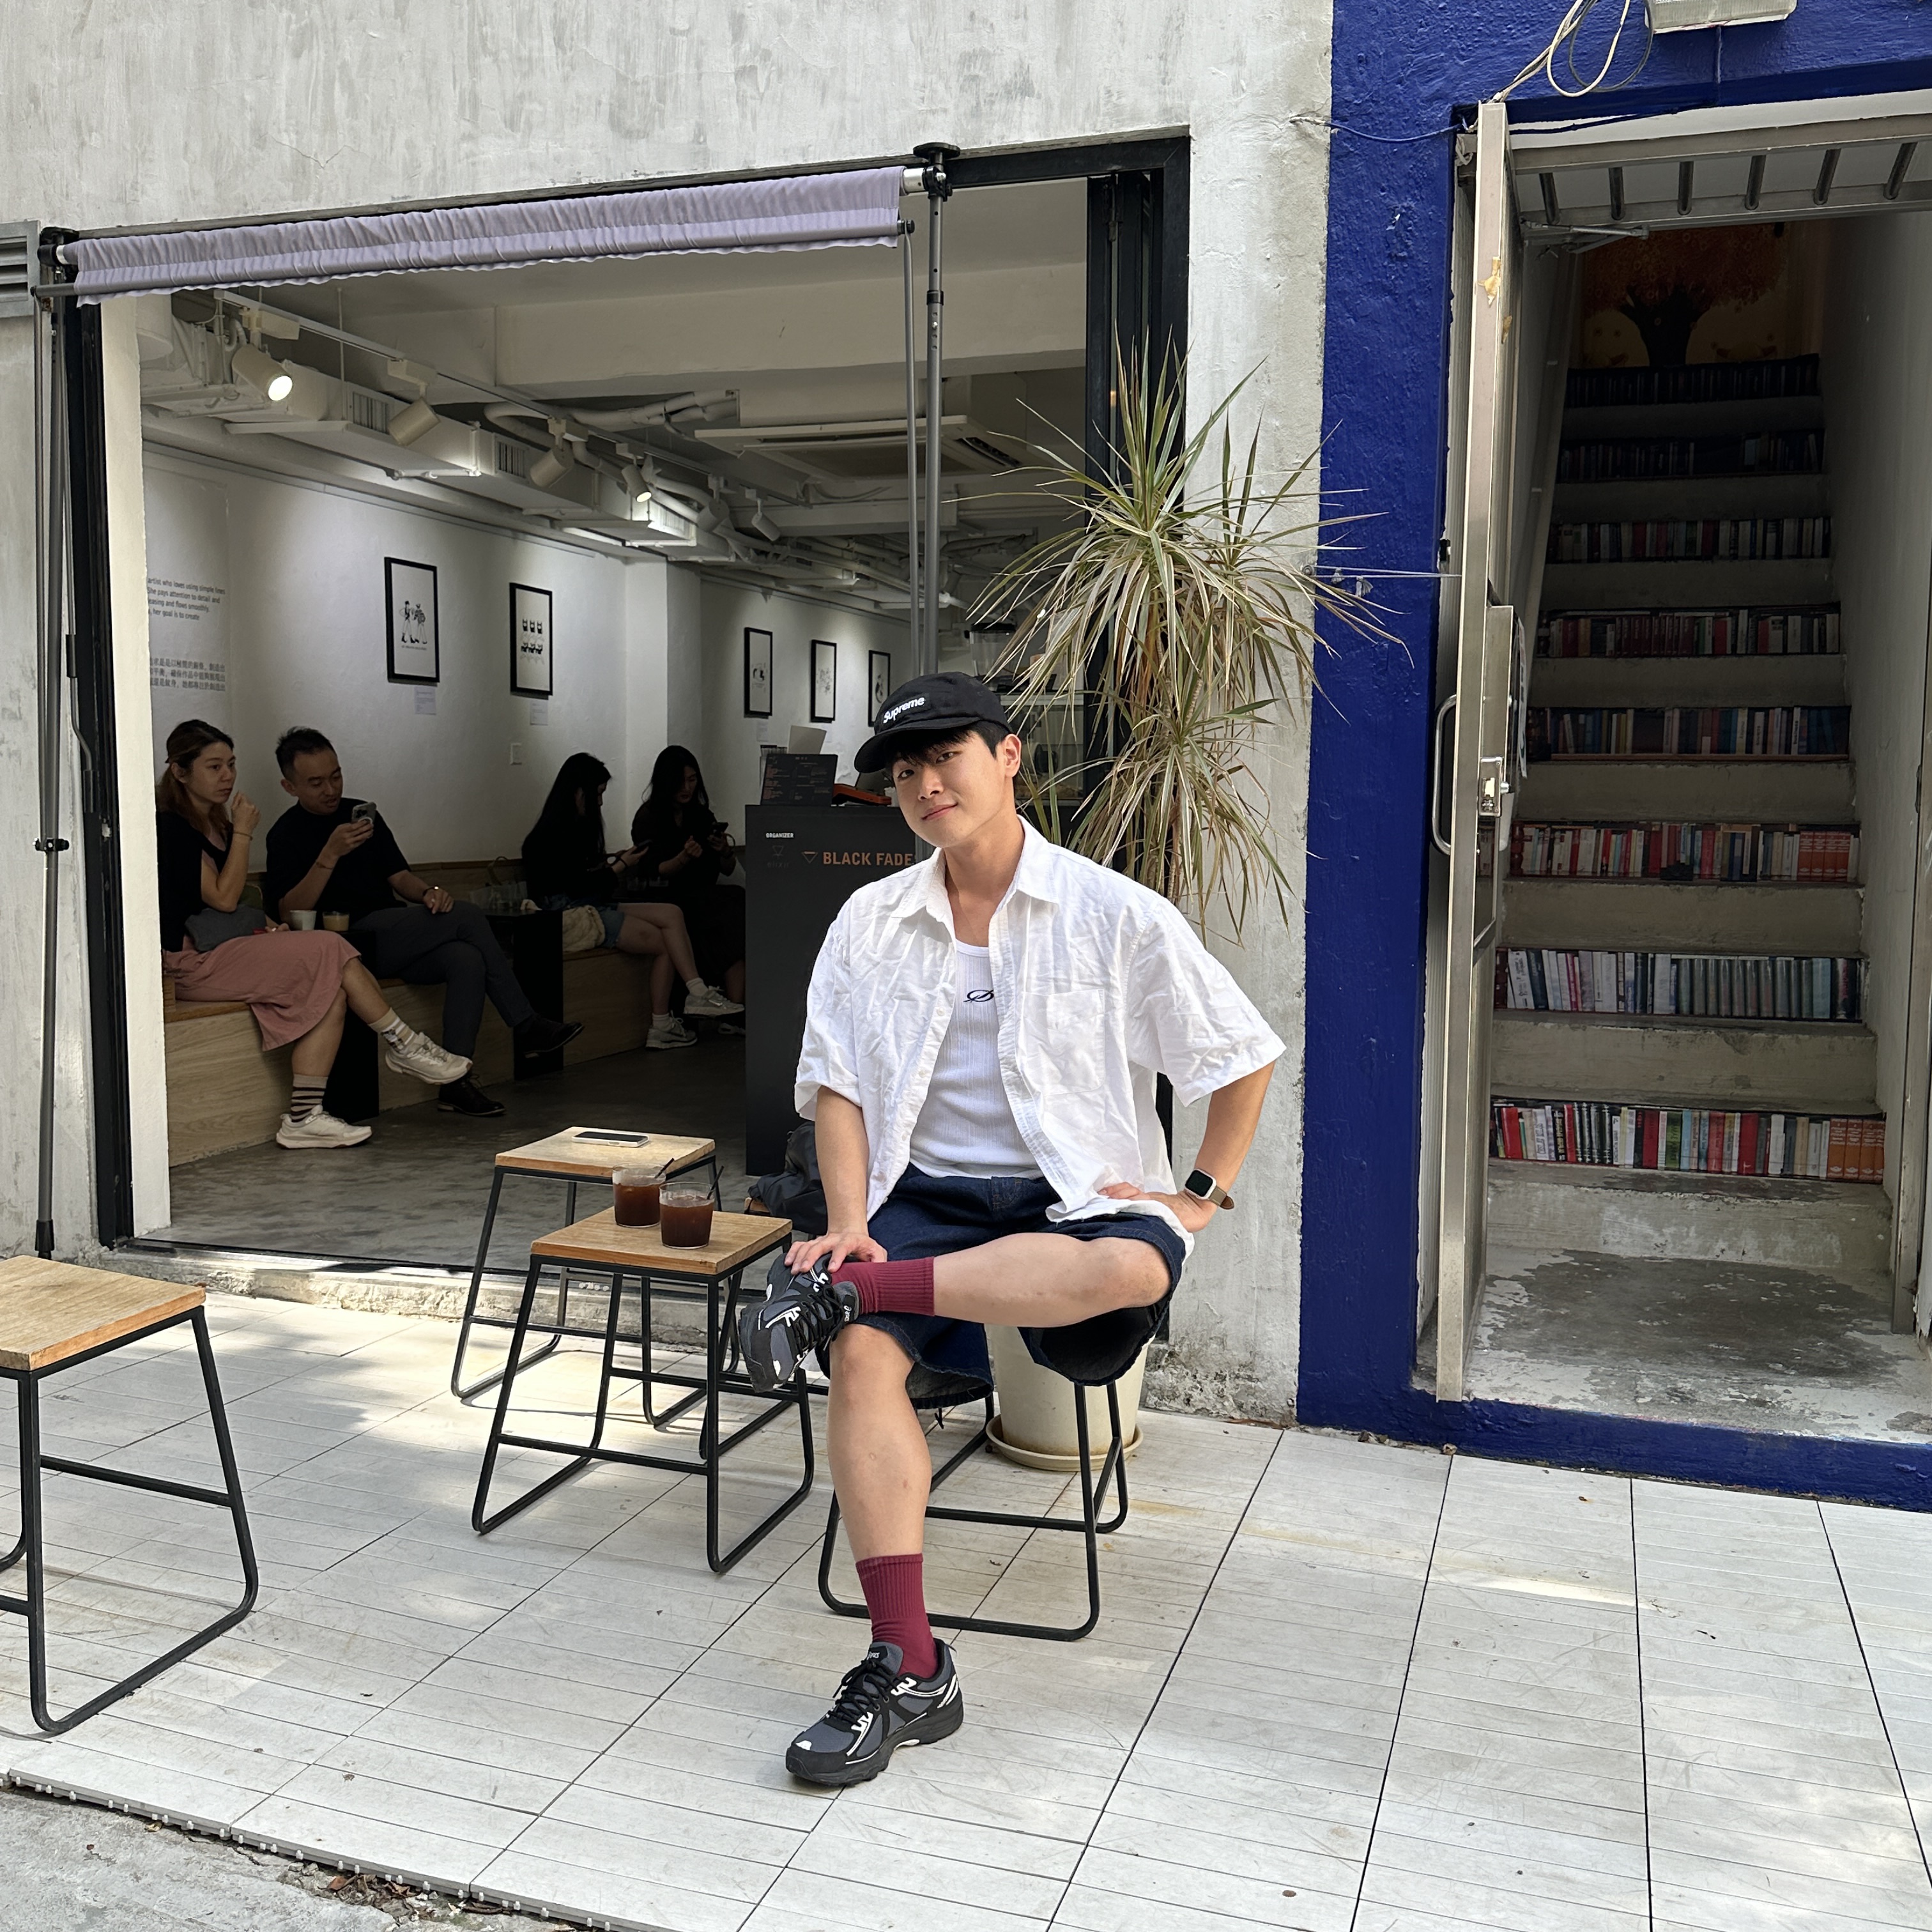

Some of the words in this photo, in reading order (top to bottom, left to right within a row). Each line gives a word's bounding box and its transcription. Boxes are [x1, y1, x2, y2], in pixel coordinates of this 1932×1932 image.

[170, 590, 190, 600] attention
[198, 594, 210, 602] detail
[163, 609, 173, 618] goal
[185, 613, 199, 621] create
[883, 697, 925, 724] Supreme
[823, 852, 871, 866] BLACK
[877, 852, 916, 866] FADE
